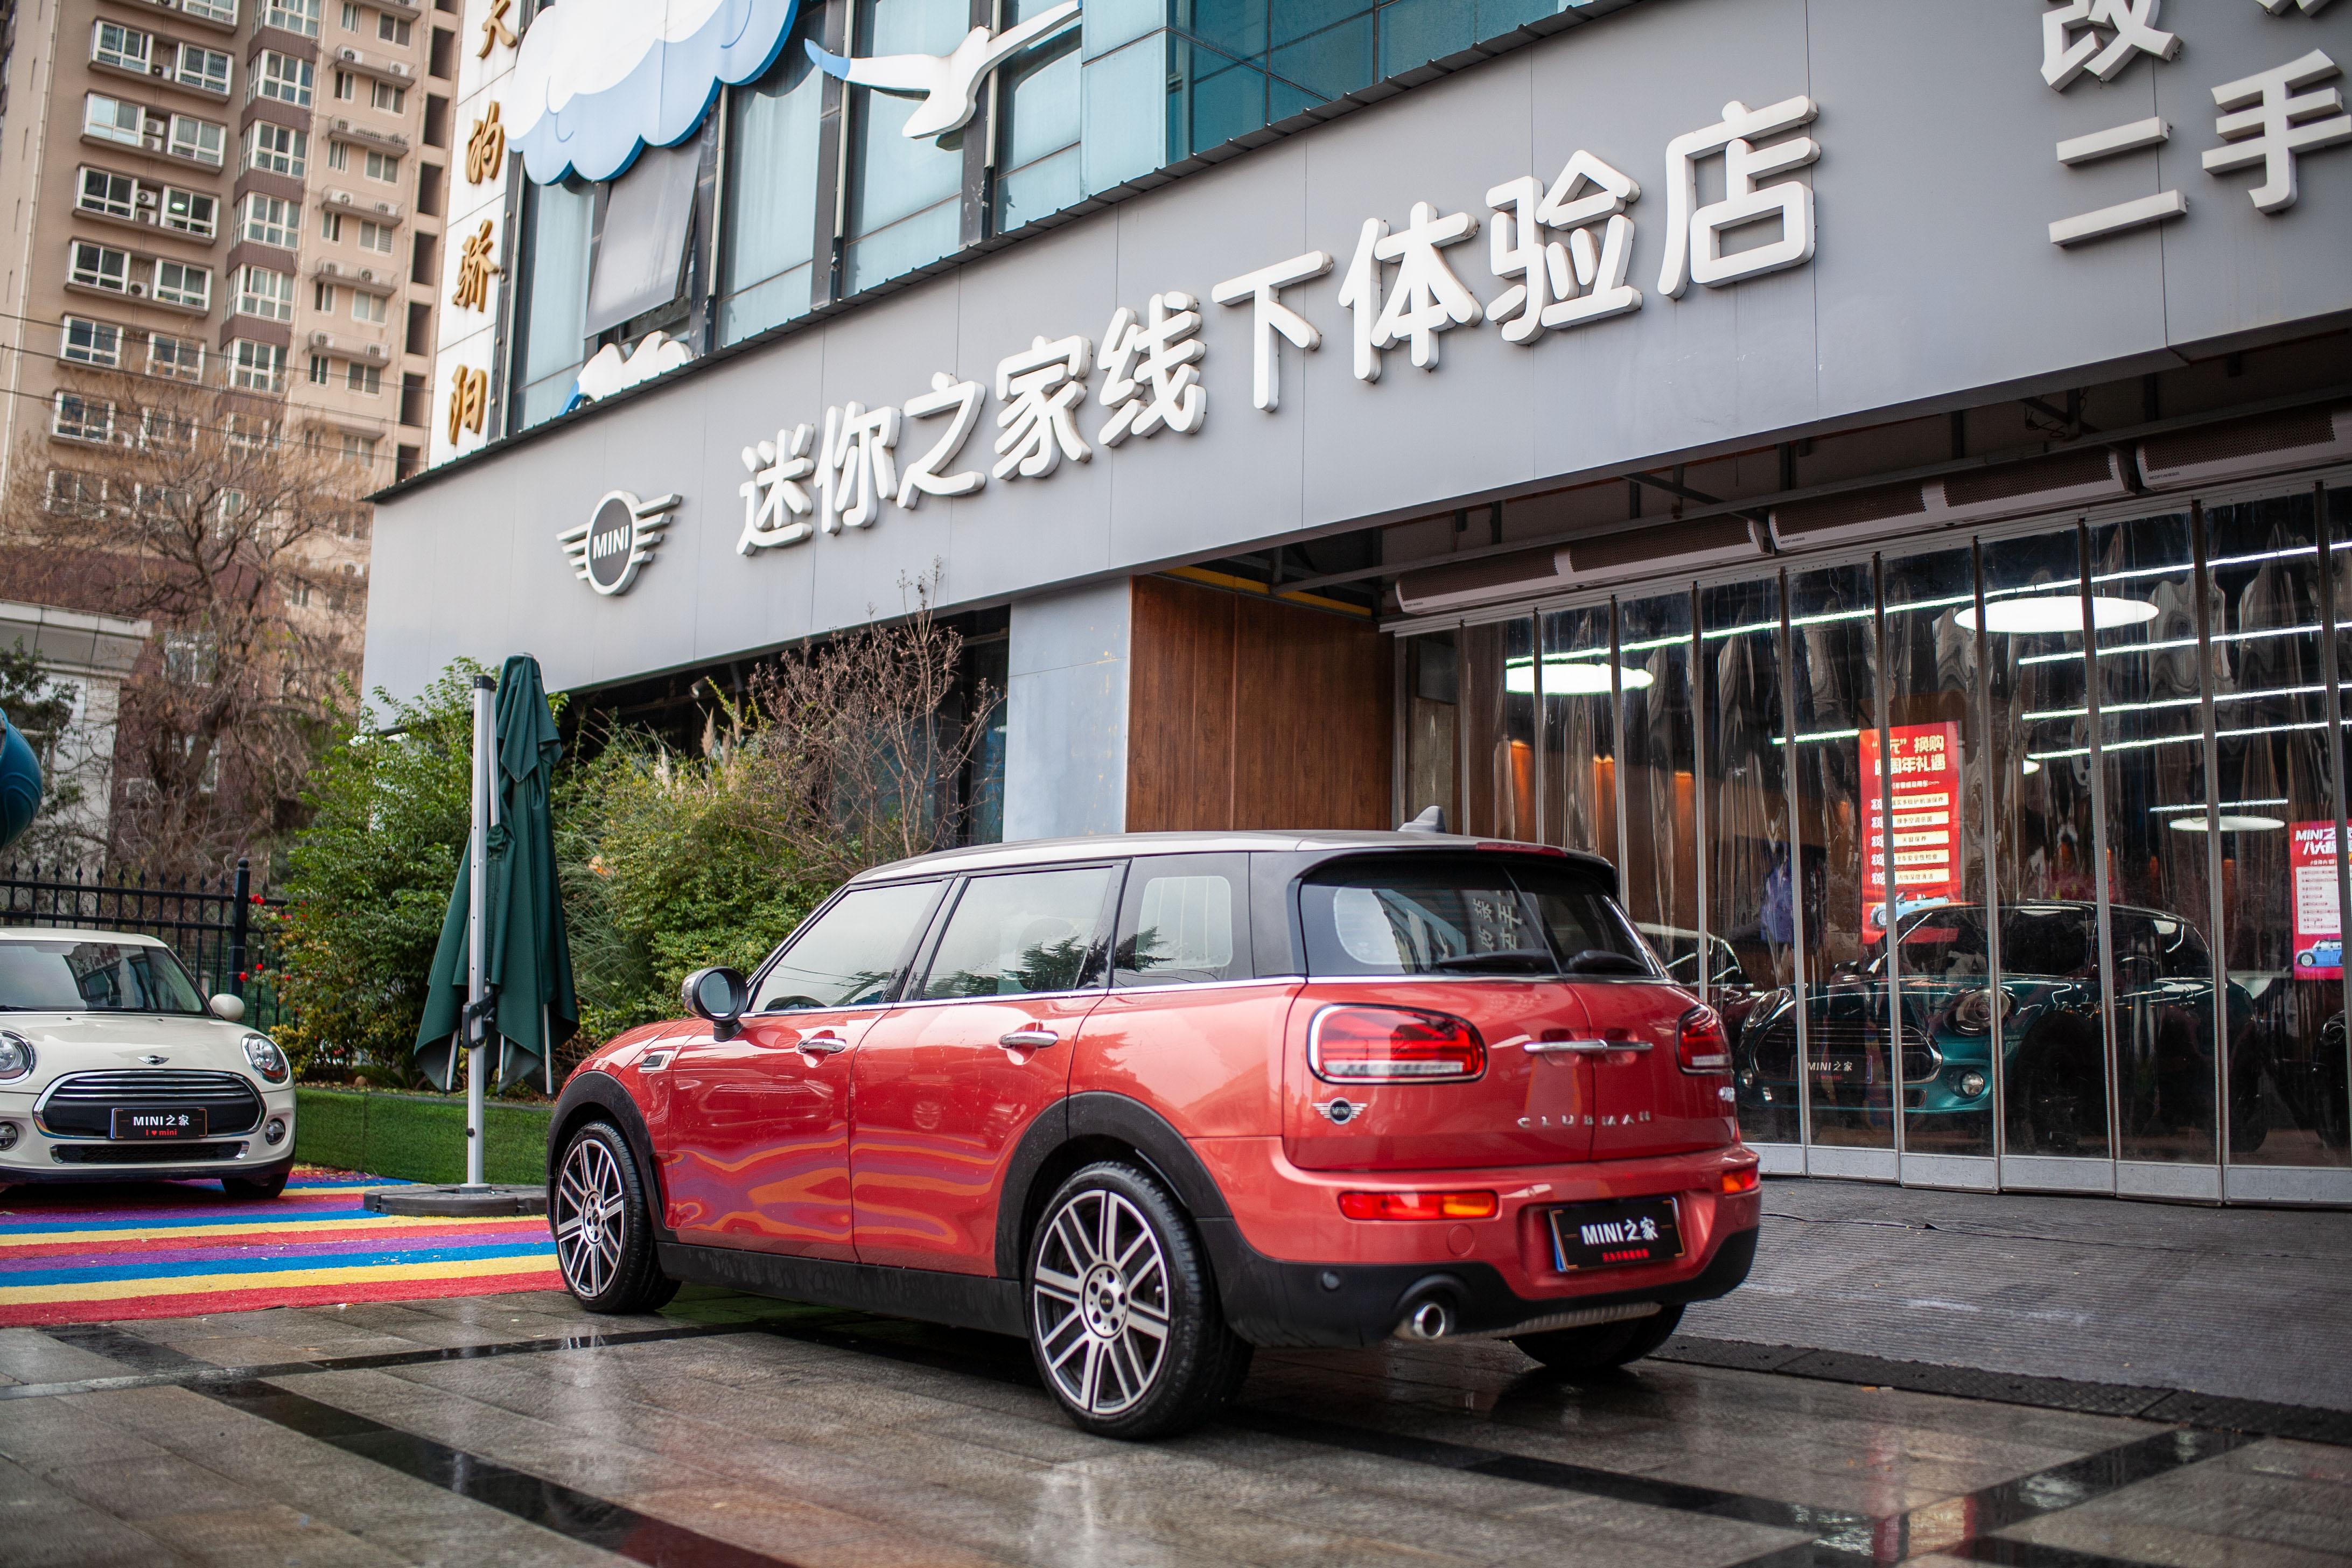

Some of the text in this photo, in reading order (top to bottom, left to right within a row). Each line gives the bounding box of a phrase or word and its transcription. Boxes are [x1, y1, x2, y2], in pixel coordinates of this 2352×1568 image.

[2048, 47, 2352, 250] 二手
[737, 94, 1821, 556] 迷你之家线下体验店
[593, 524, 629, 560] MINI
[1807, 1061, 1852, 1072] MINI之家
[133, 1114, 190, 1126] MINI之家
[1517, 1111, 1651, 1128] CLUBMAN
[1581, 1216, 1658, 1245] MINI之家
